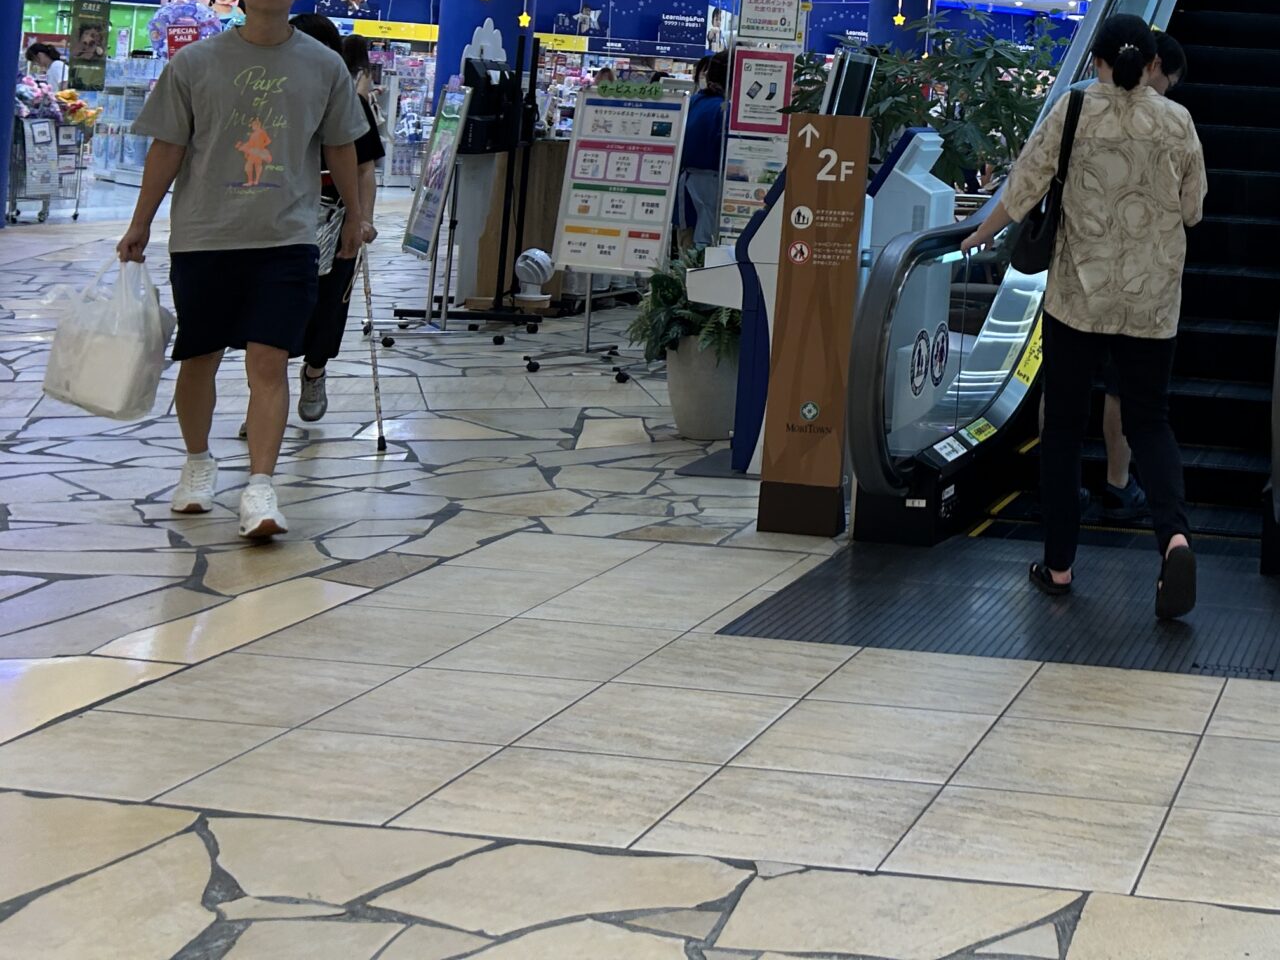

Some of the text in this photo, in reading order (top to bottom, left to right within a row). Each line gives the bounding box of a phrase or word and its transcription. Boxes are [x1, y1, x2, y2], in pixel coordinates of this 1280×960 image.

[82, 3, 101, 12] SALE
[168, 28, 198, 36] SPECIAL
[600, 84, 662, 97] サービス・ガイド
[816, 148, 855, 182] 2F
